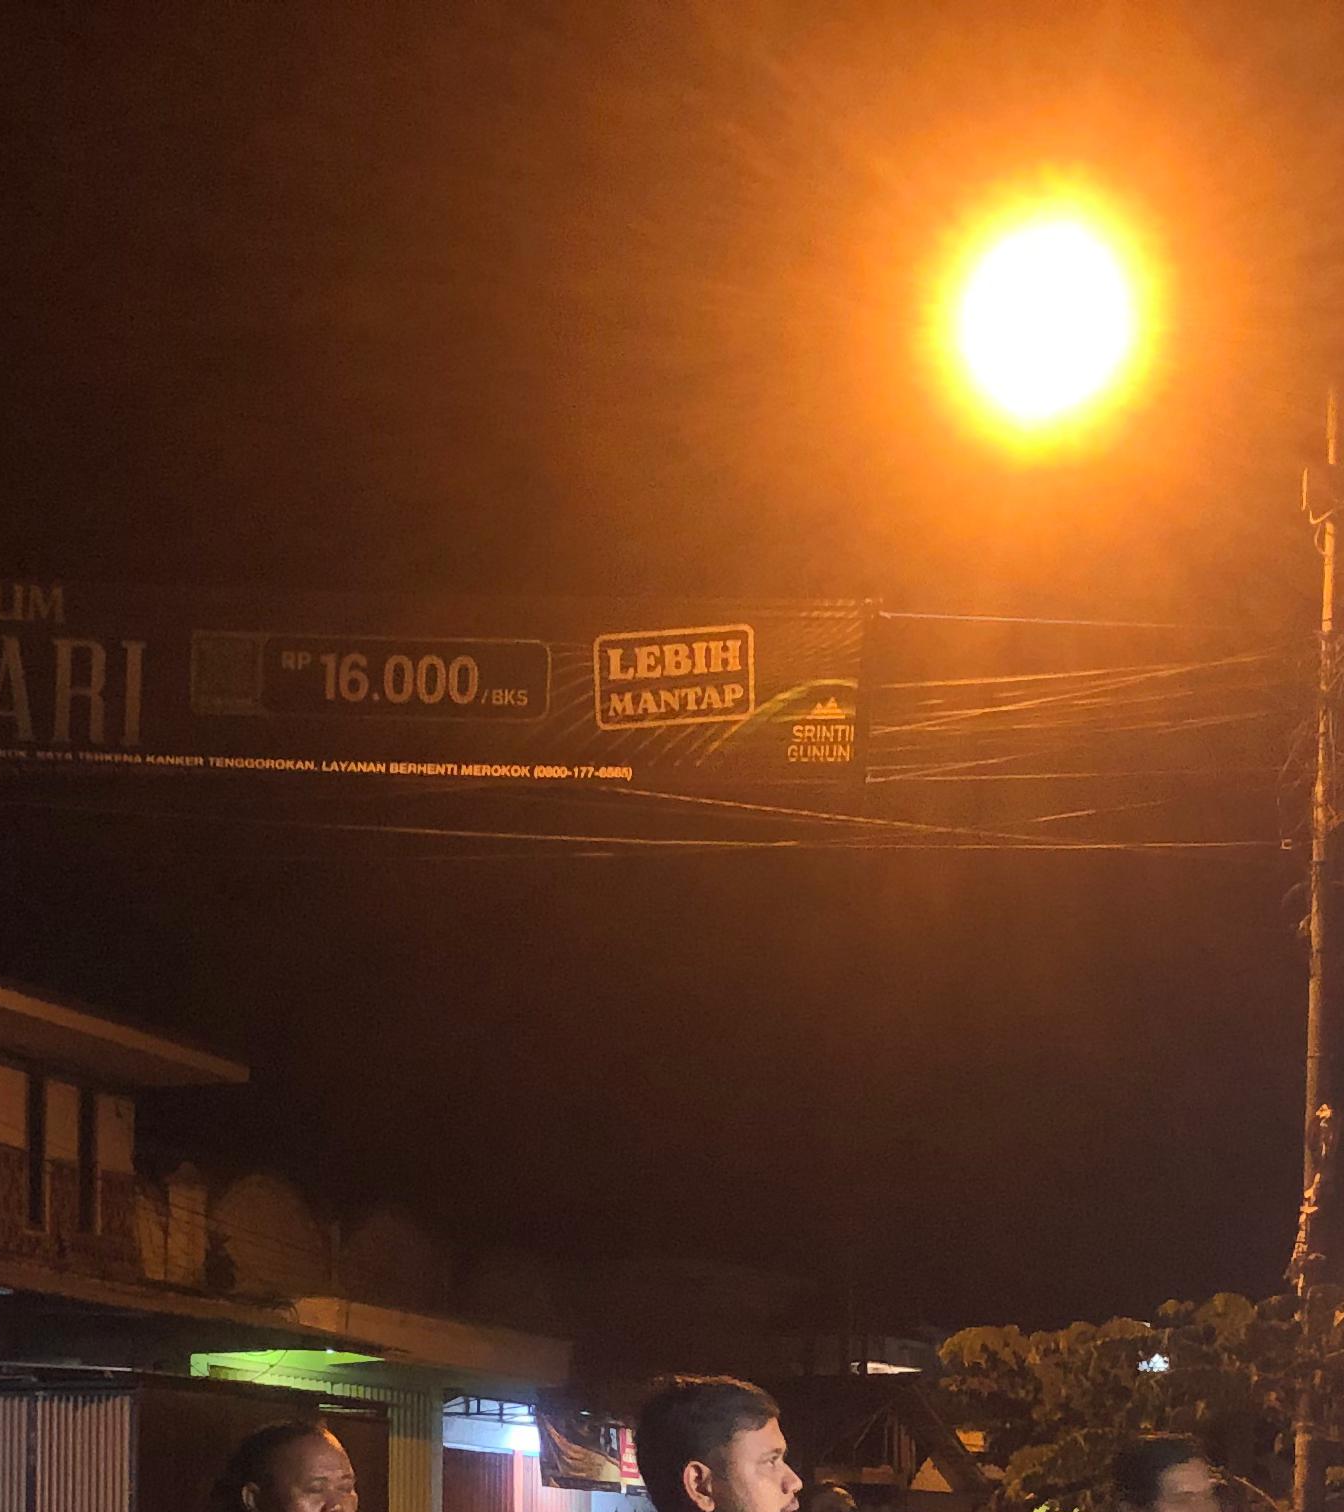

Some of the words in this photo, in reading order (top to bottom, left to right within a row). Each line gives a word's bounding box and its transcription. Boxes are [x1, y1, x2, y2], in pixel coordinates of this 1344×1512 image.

[281, 650, 312, 671] RP
[320, 654, 479, 704] 16.000
[605, 638, 743, 681] LEBIH
[606, 682, 744, 718] MANTAP
[146, 753, 204, 767] KANKER
[208, 756, 318, 771] TENGGOROKAN.
[322, 759, 386, 774] LAYANAN
[390, 762, 457, 776] BERHENTI
[460, 764, 530, 778] MEROKOK
[787, 743, 854, 763] GUNUN
